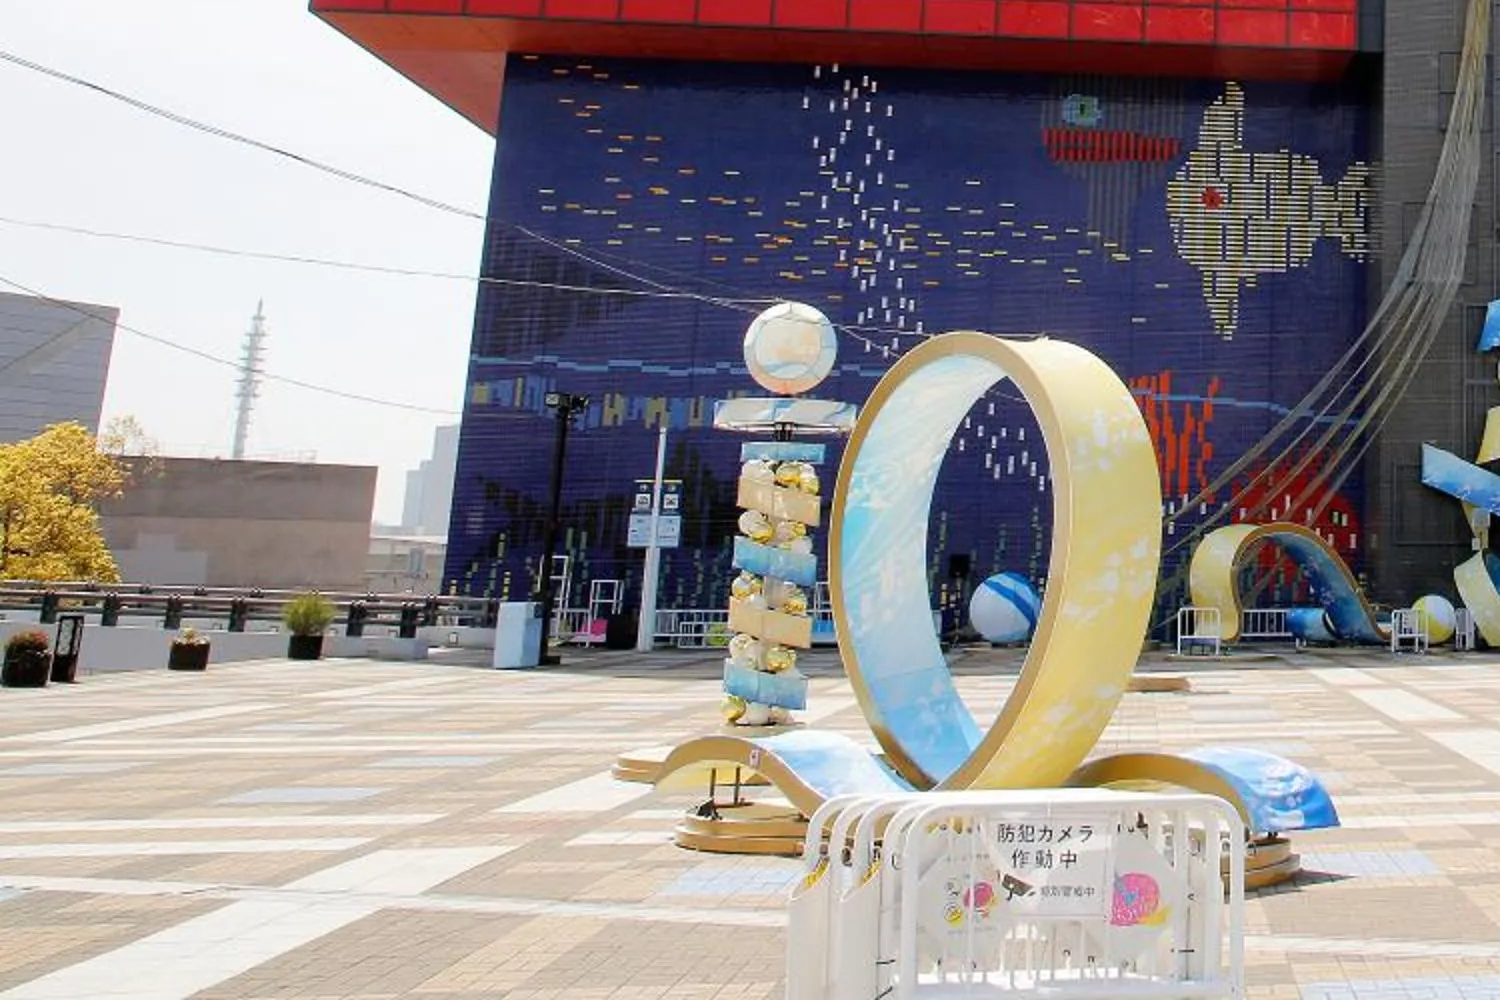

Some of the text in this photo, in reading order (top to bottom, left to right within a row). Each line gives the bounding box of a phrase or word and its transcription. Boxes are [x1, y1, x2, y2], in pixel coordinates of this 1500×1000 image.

[997, 823, 1094, 843] 防犯カメラ
[1011, 848, 1078, 869] 作動中
